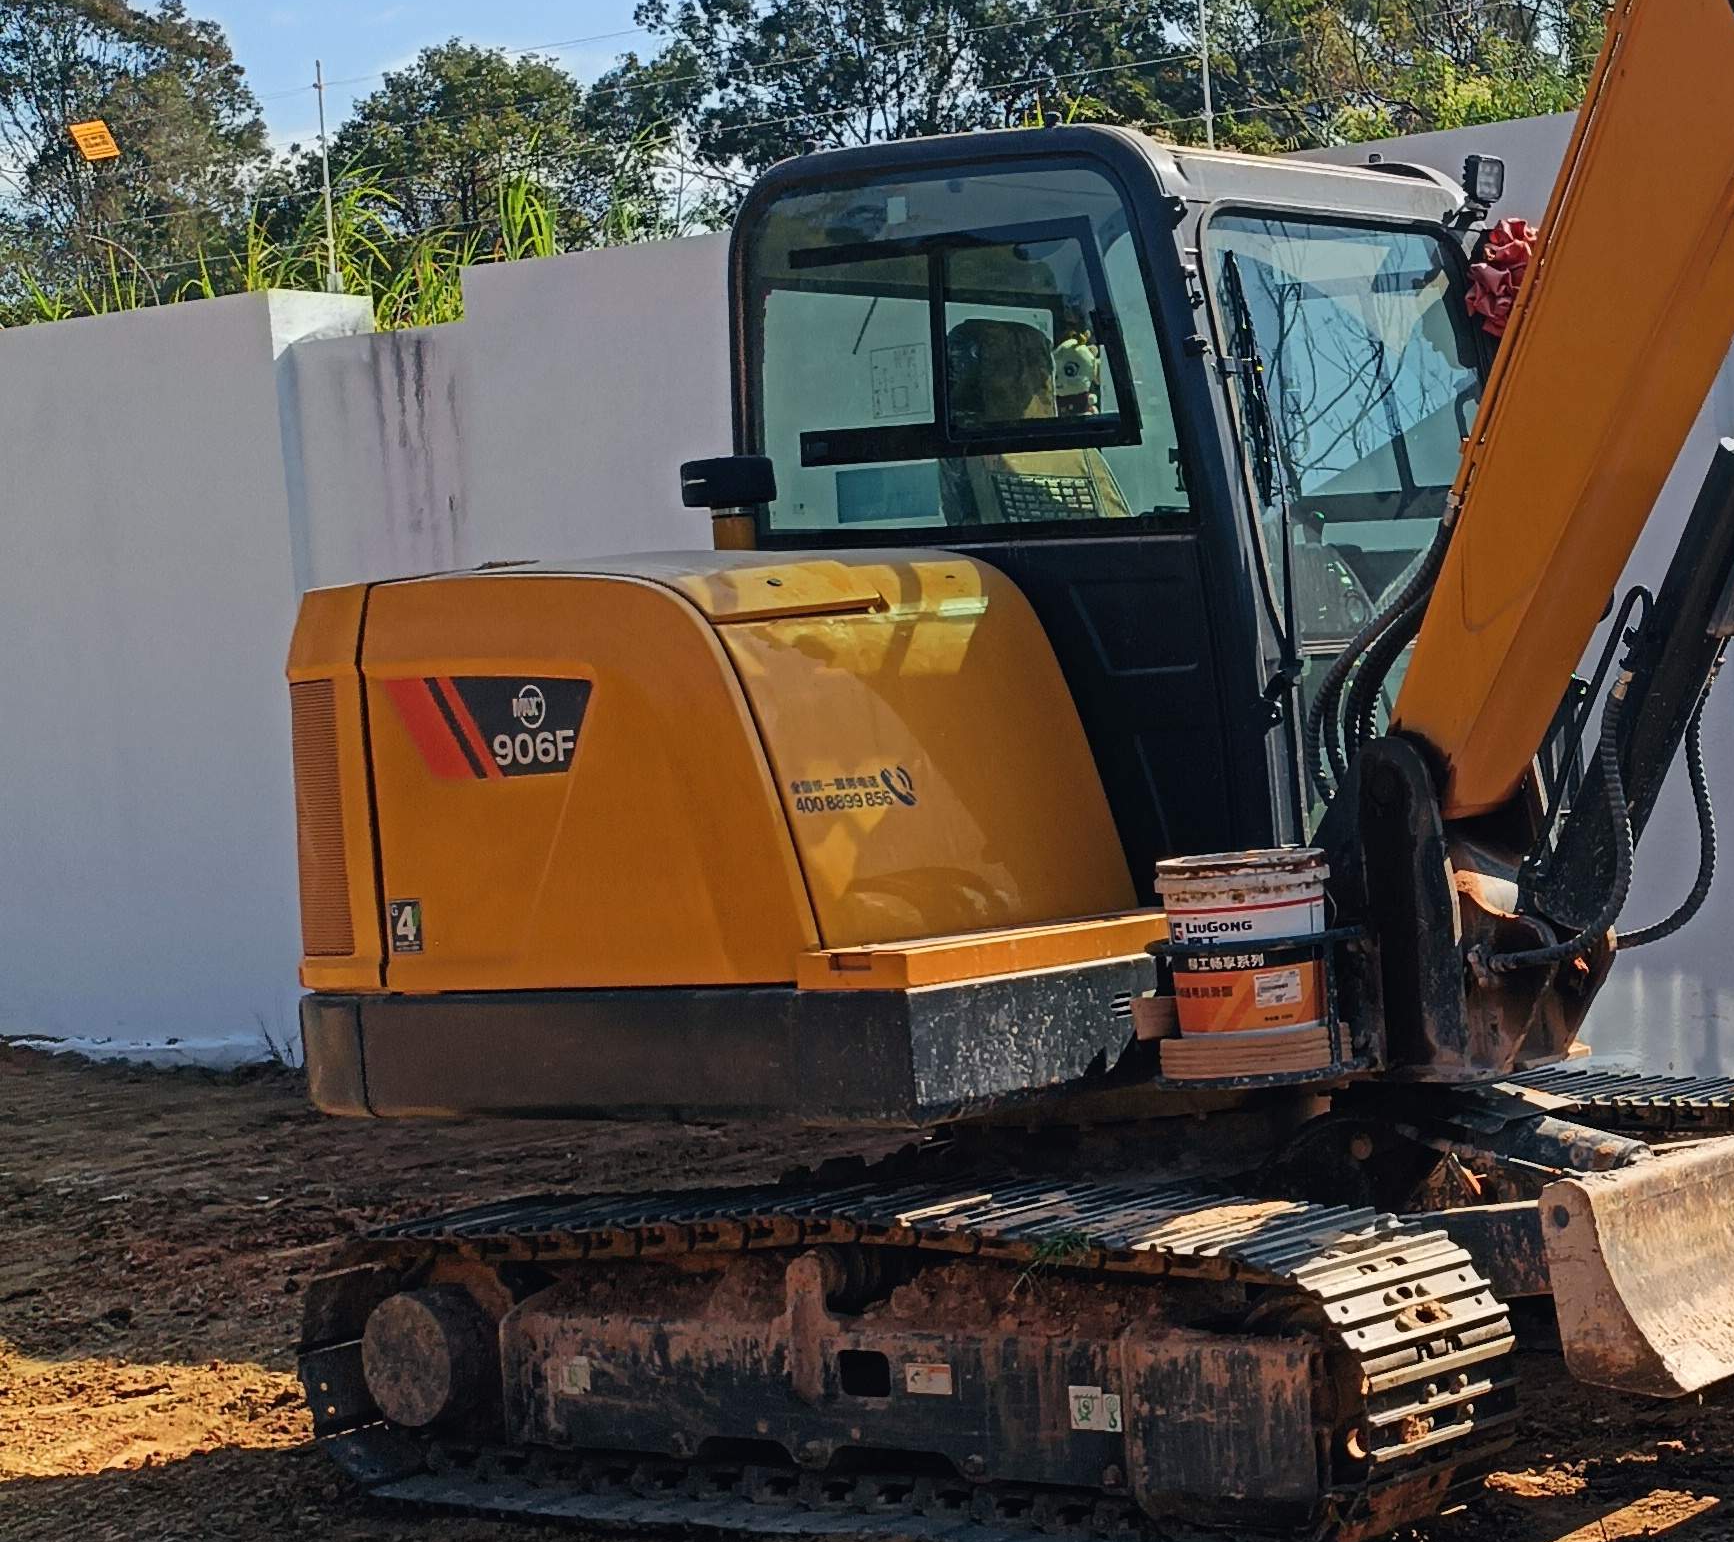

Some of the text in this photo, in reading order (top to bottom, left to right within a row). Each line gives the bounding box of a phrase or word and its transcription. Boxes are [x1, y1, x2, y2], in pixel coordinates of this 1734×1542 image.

[493, 729, 574, 766] 906F
[796, 791, 893, 813] 400 8899 856
[1186, 920, 1252, 933] LIUGONG
